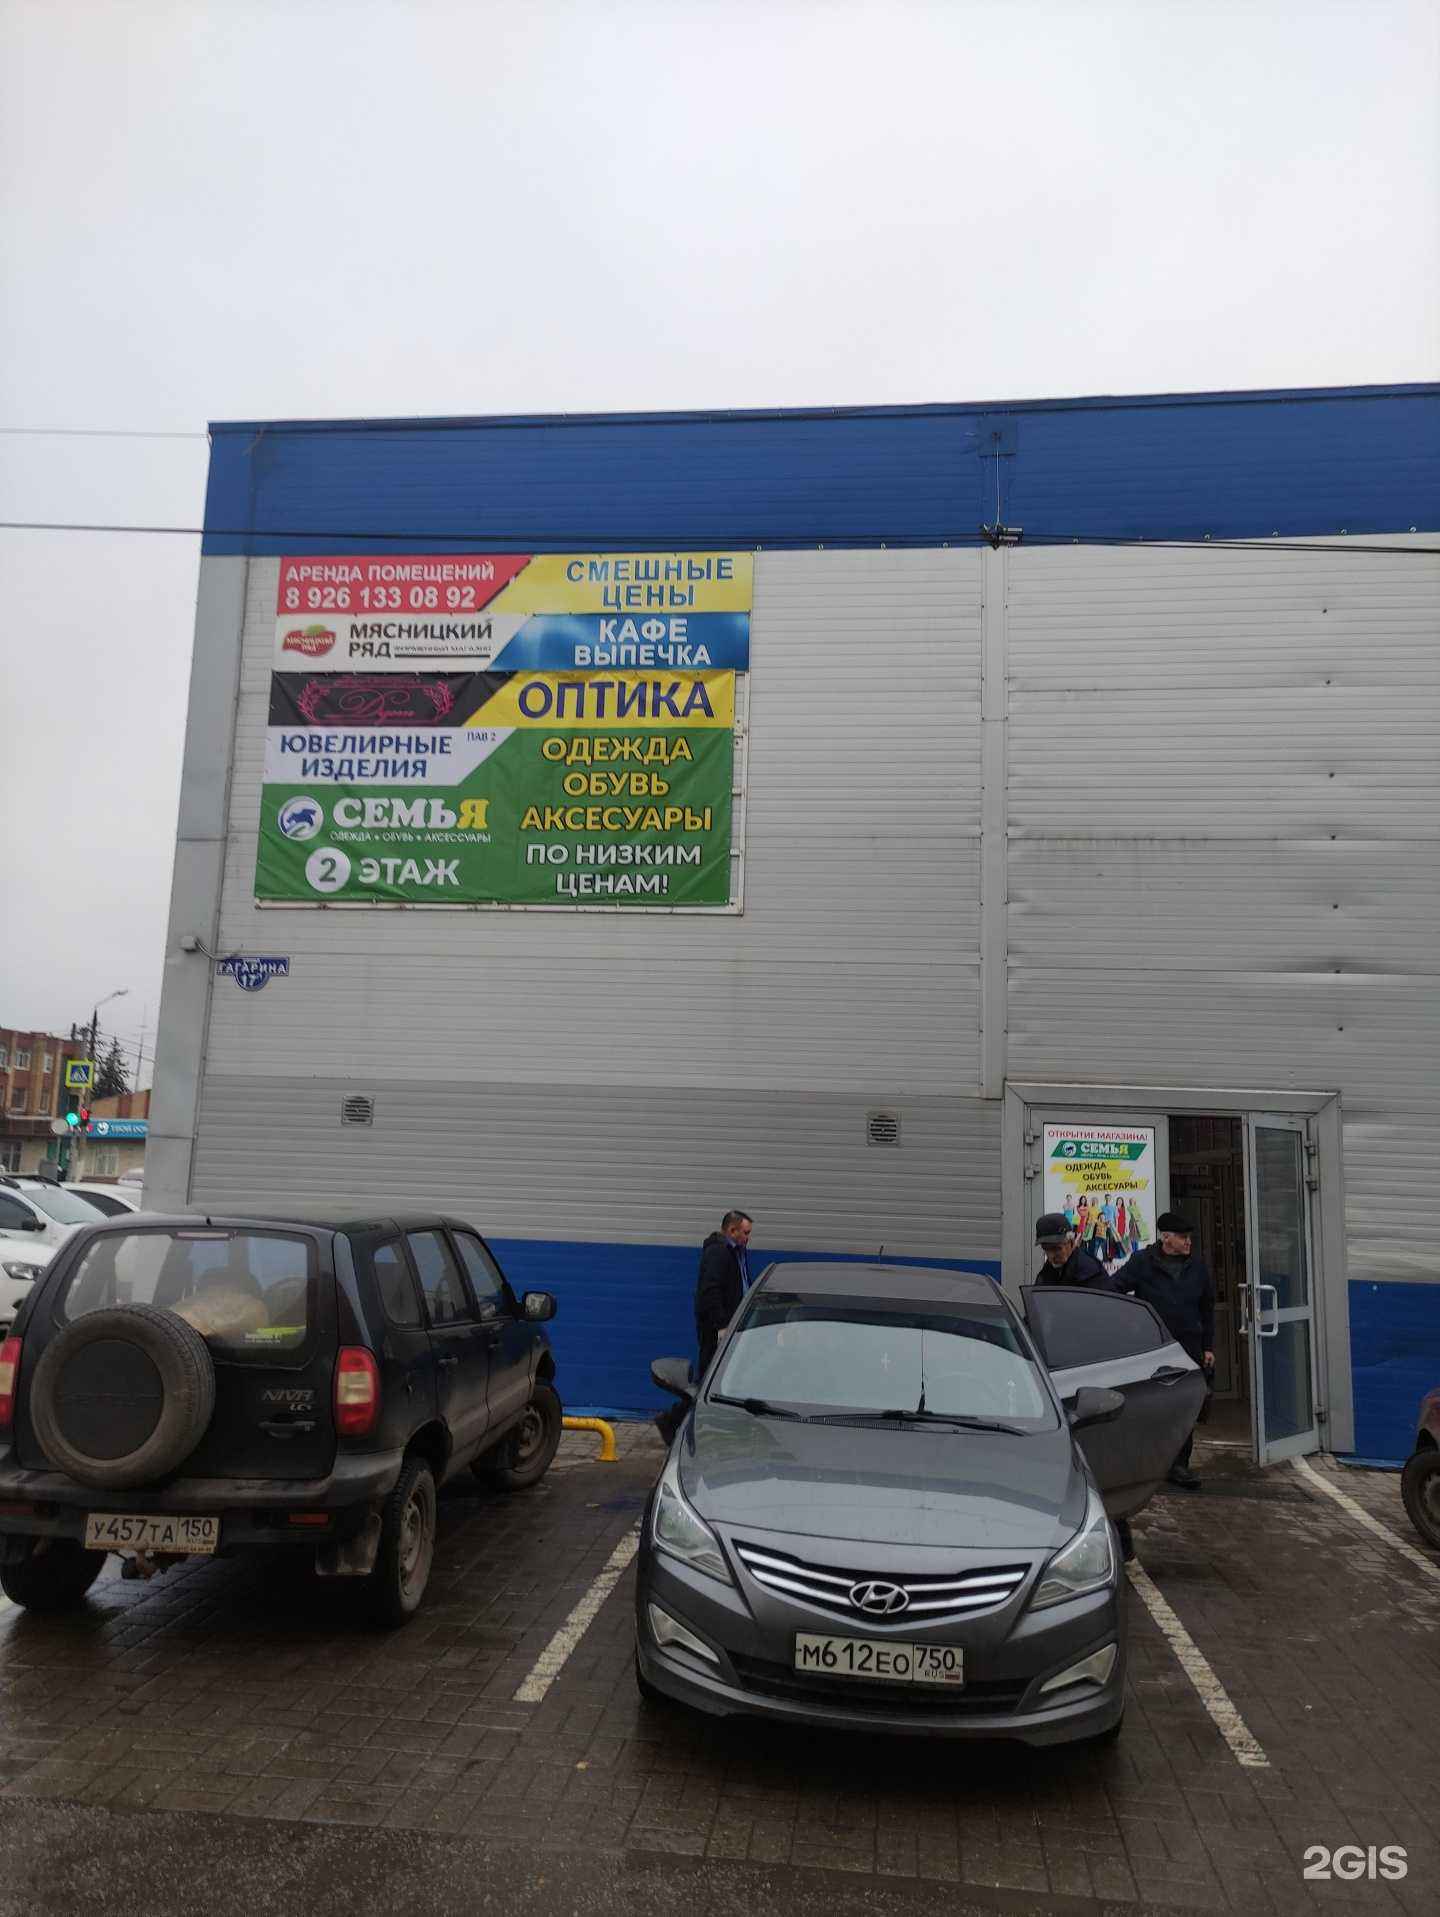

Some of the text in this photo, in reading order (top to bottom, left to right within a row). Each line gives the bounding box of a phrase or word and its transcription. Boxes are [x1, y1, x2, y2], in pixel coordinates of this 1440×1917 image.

[286, 560, 495, 585] АРЕНДА ПОМЕЩЕНИЙ
[566, 558, 734, 582] СМЕШНЫЕ
[286, 586, 476, 609] 8 926 133 08 92
[603, 584, 695, 611] ЦЕНЫ
[349, 618, 493, 641] МЯСНИЦКИЙ
[600, 618, 688, 643] КАФЕ
[348, 642, 392, 659] РЯД
[574, 644, 712, 666] ВЫПЕЧКА
[518, 681, 715, 719] ОПТИКА
[280, 734, 453, 754] ЮВЕЛИРНЫЕ
[542, 737, 694, 766] ОДЕЖДА
[301, 758, 428, 781] ИЗДЕЛИЯ
[562, 771, 670, 797] ОБУВЬ
[332, 797, 490, 830] СЕМЬЯ
[520, 806, 713, 831] АКСЕСУАРЫ
[526, 843, 701, 865] ПО НИЗКИМ
[319, 856, 462, 886] 2 ЭТАЖ
[556, 873, 669, 897] ЦЕНАМ!
[1080, 1142, 1129, 1155] СЕМЬЯ
[1065, 1162, 1107, 1173] ОДЕЖДА
[1082, 1173, 1112, 1181] ОБУВЬ
[1085, 1182, 1138, 1192] АКСЕСУАРЫ
